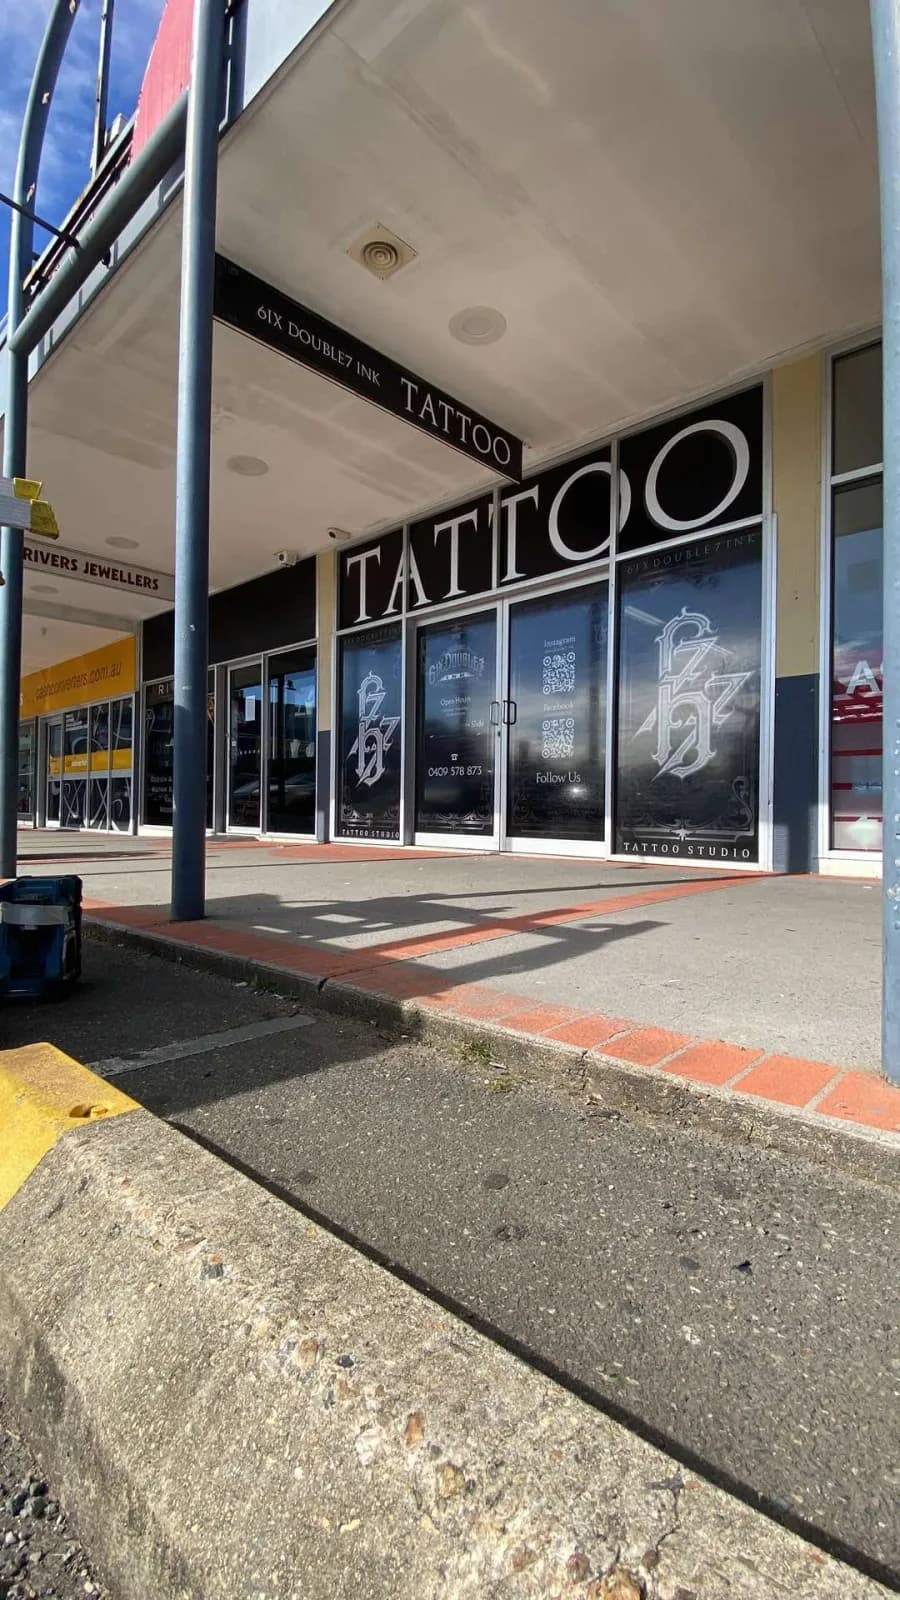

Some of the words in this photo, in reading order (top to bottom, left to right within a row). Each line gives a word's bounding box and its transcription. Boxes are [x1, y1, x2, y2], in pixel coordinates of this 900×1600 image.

[257, 305, 283, 330] 6IX
[287, 320, 353, 369] DOUBLE7
[356, 360, 381, 387] INK
[400, 377, 511, 465] TATTOO
[346, 419, 750, 624] TATTOO
[23, 547, 78, 571] RIVERS
[83, 561, 159, 590] JEWELLERS
[428, 767, 448, 777] 0409
[450, 766, 465, 777] 578
[466, 765, 482, 776] 873
[536, 772, 565, 784] Follow
[568, 772, 581, 783] Us
[371, 830, 400, 839] STUDIO
[623, 842, 680, 854] TATTOO
[687, 846, 750, 858] STUDIO
